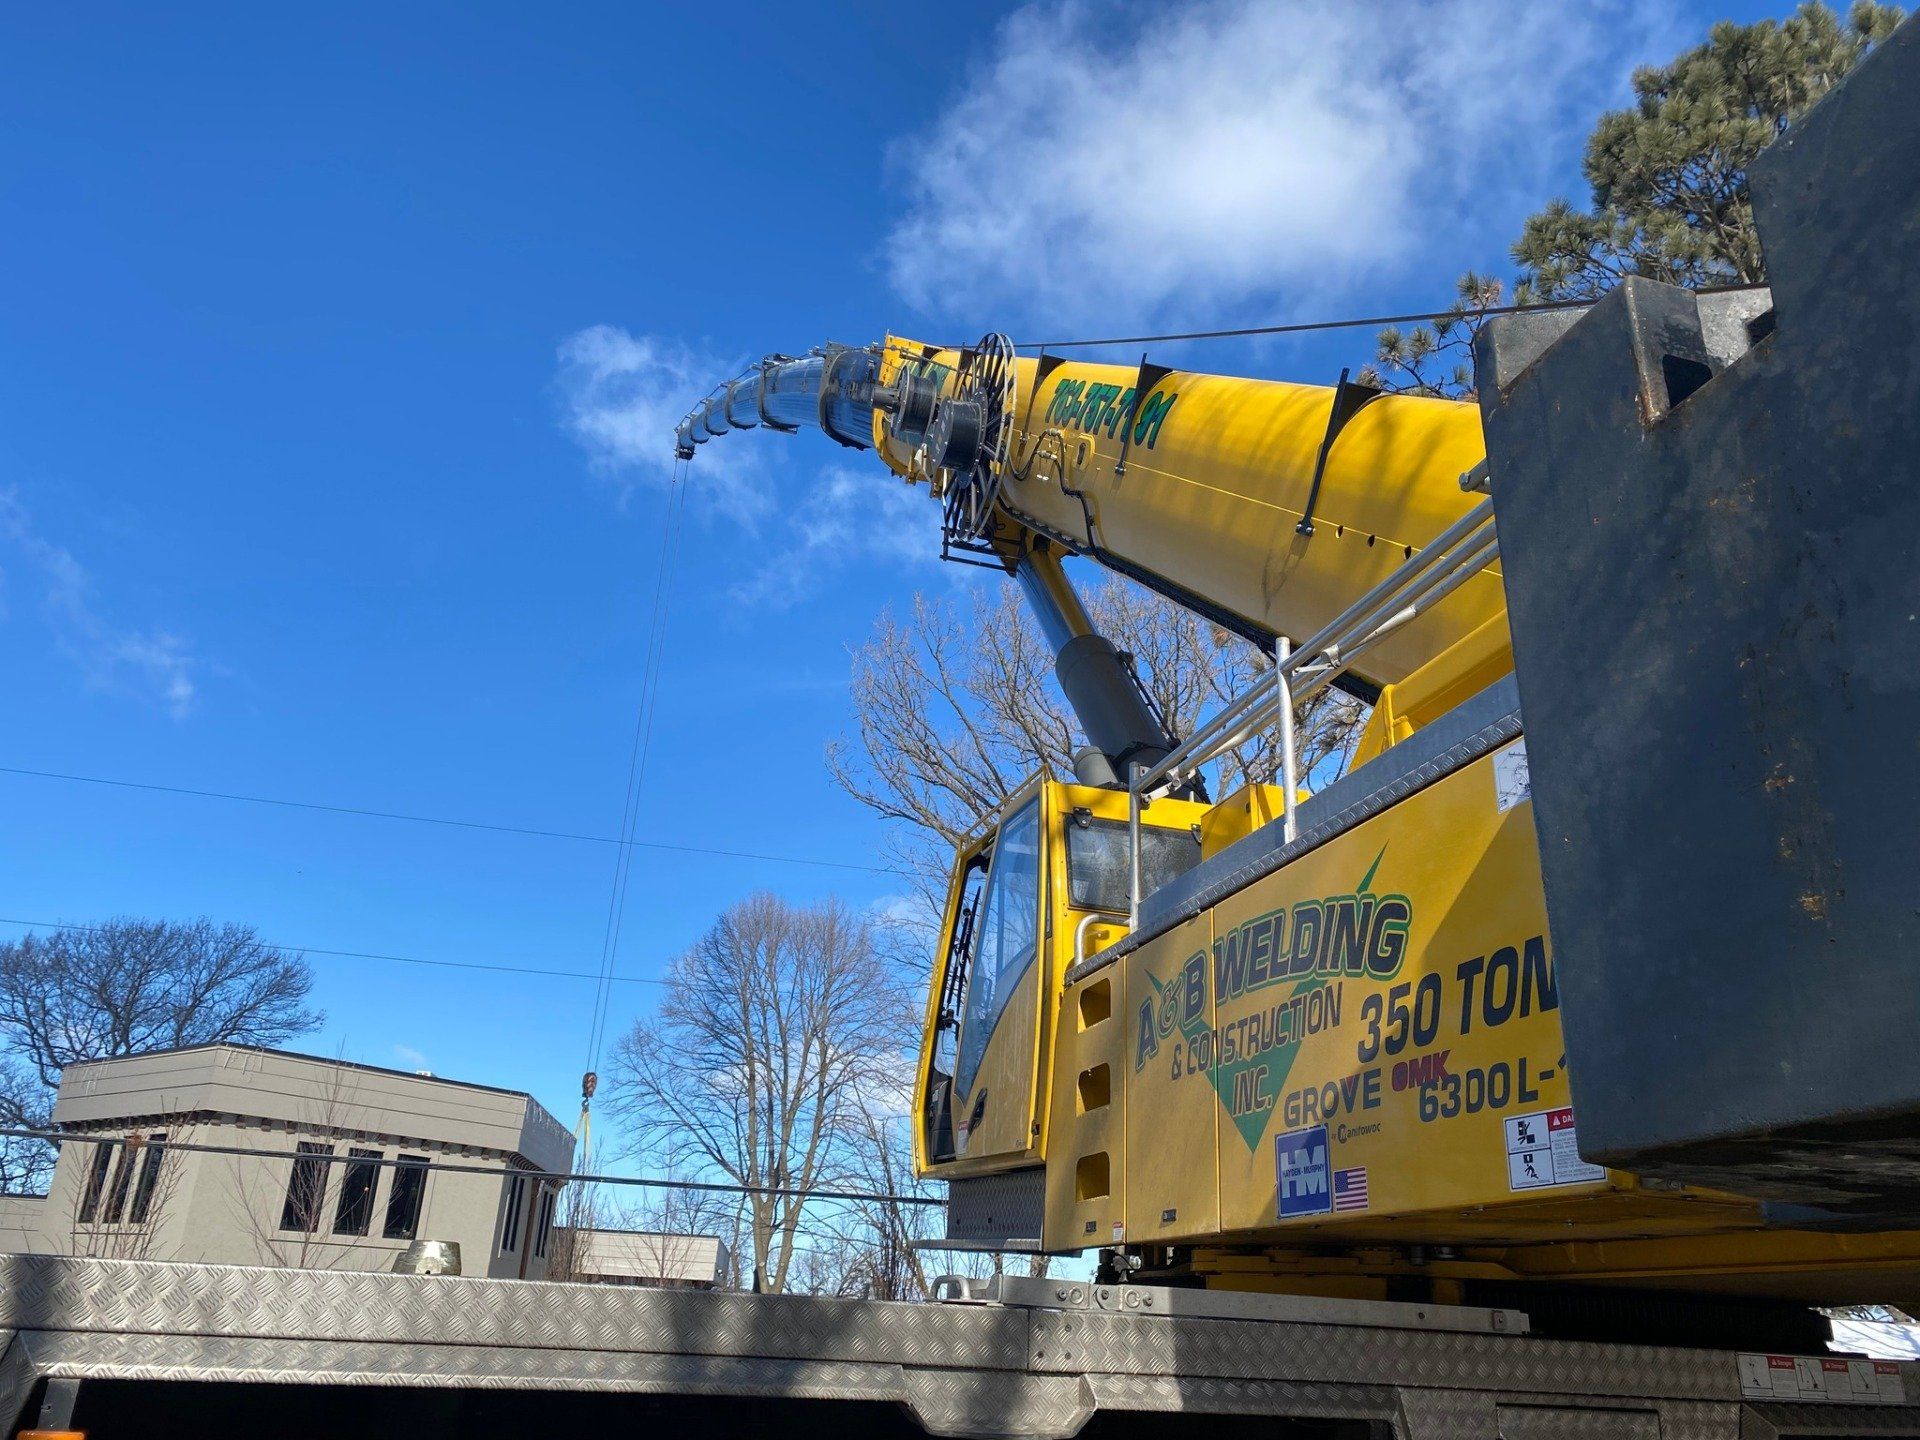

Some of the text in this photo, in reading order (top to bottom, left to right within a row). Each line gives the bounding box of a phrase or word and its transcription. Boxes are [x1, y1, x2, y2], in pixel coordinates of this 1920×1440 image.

[1213, 894, 1411, 1006] WELDING
[1187, 982, 1343, 1075] CONSTRUCTION
[1358, 935, 1560, 1064] 350 TON
[1233, 1064, 1273, 1117] INC.
[1284, 1069, 1381, 1127] GROVE
[1562, 1114, 1574, 1123] DA
